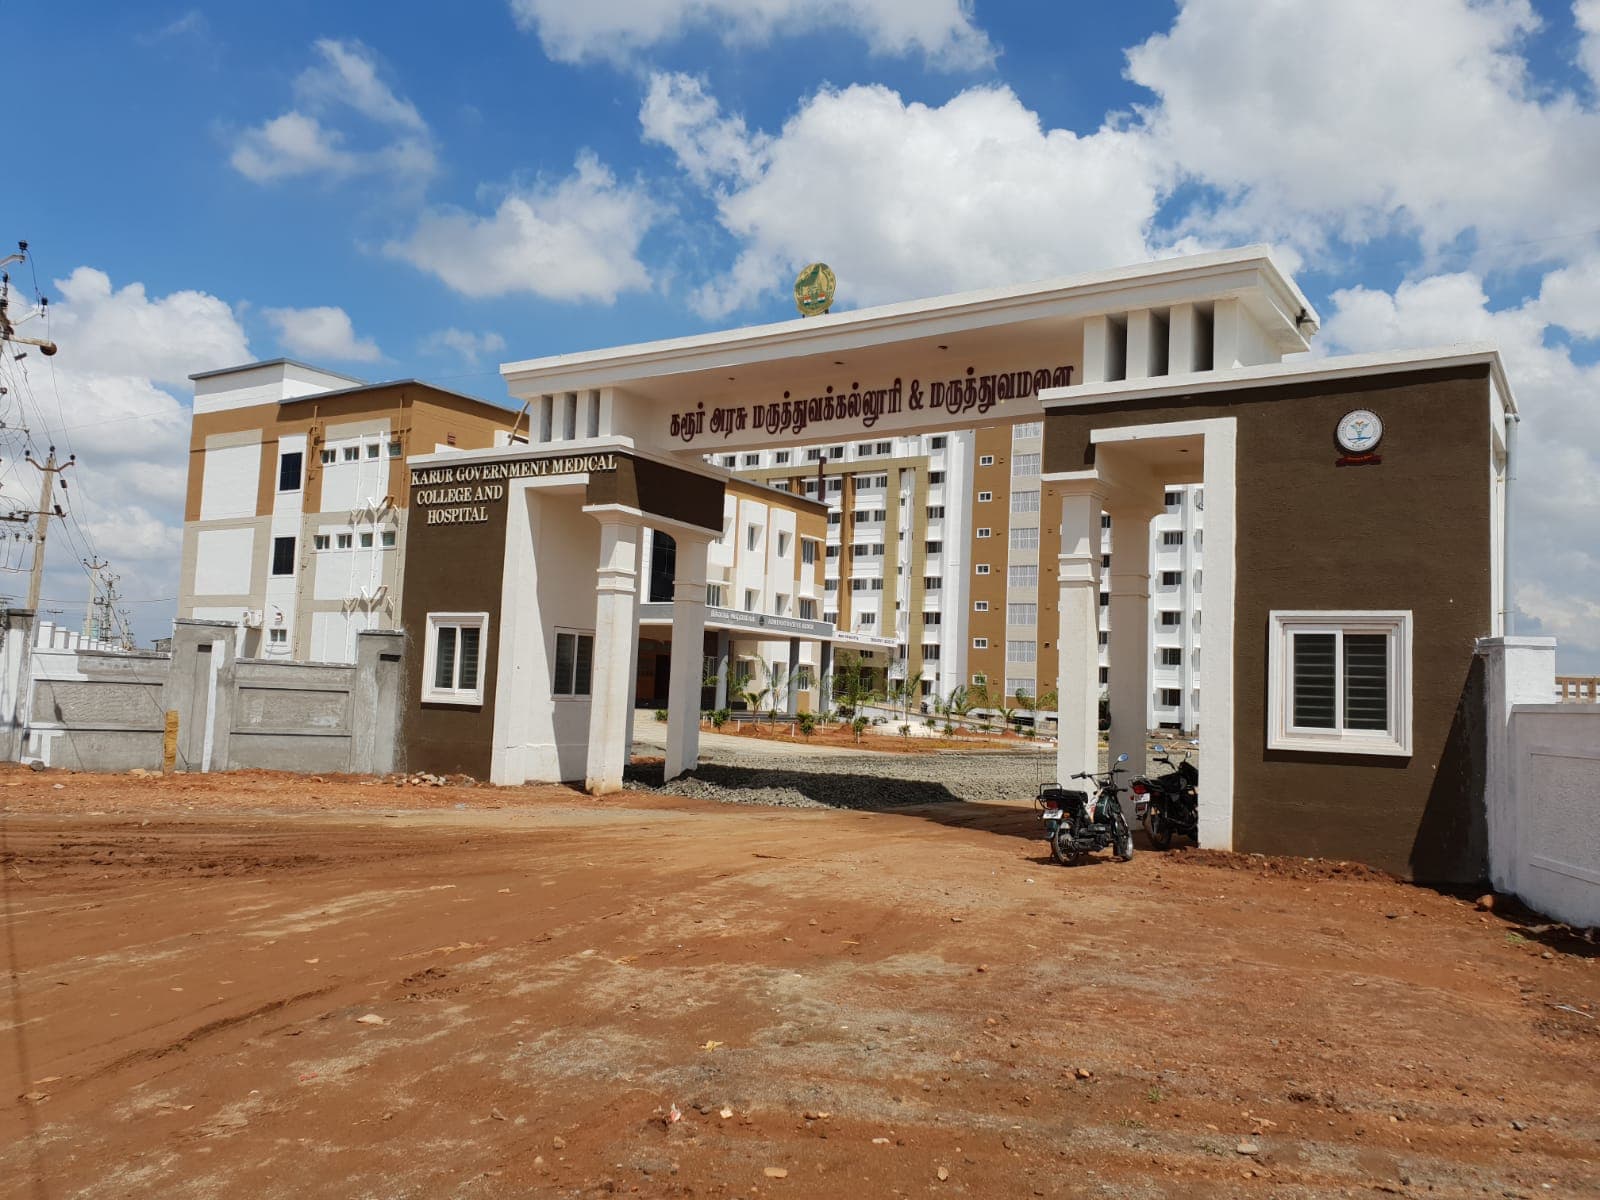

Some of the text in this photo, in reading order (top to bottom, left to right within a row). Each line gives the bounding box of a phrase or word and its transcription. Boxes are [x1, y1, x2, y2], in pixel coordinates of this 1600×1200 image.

[670, 365, 1074, 442] கரூர் அரசு மருத்துவக்கல்லூரி & மருத்துவமனை
[411, 454, 617, 486] KARUR GOVERNMENT MEDICAL
[417, 485, 503, 505] COLLEGE AND
[427, 506, 488, 524] HOSPITAL
